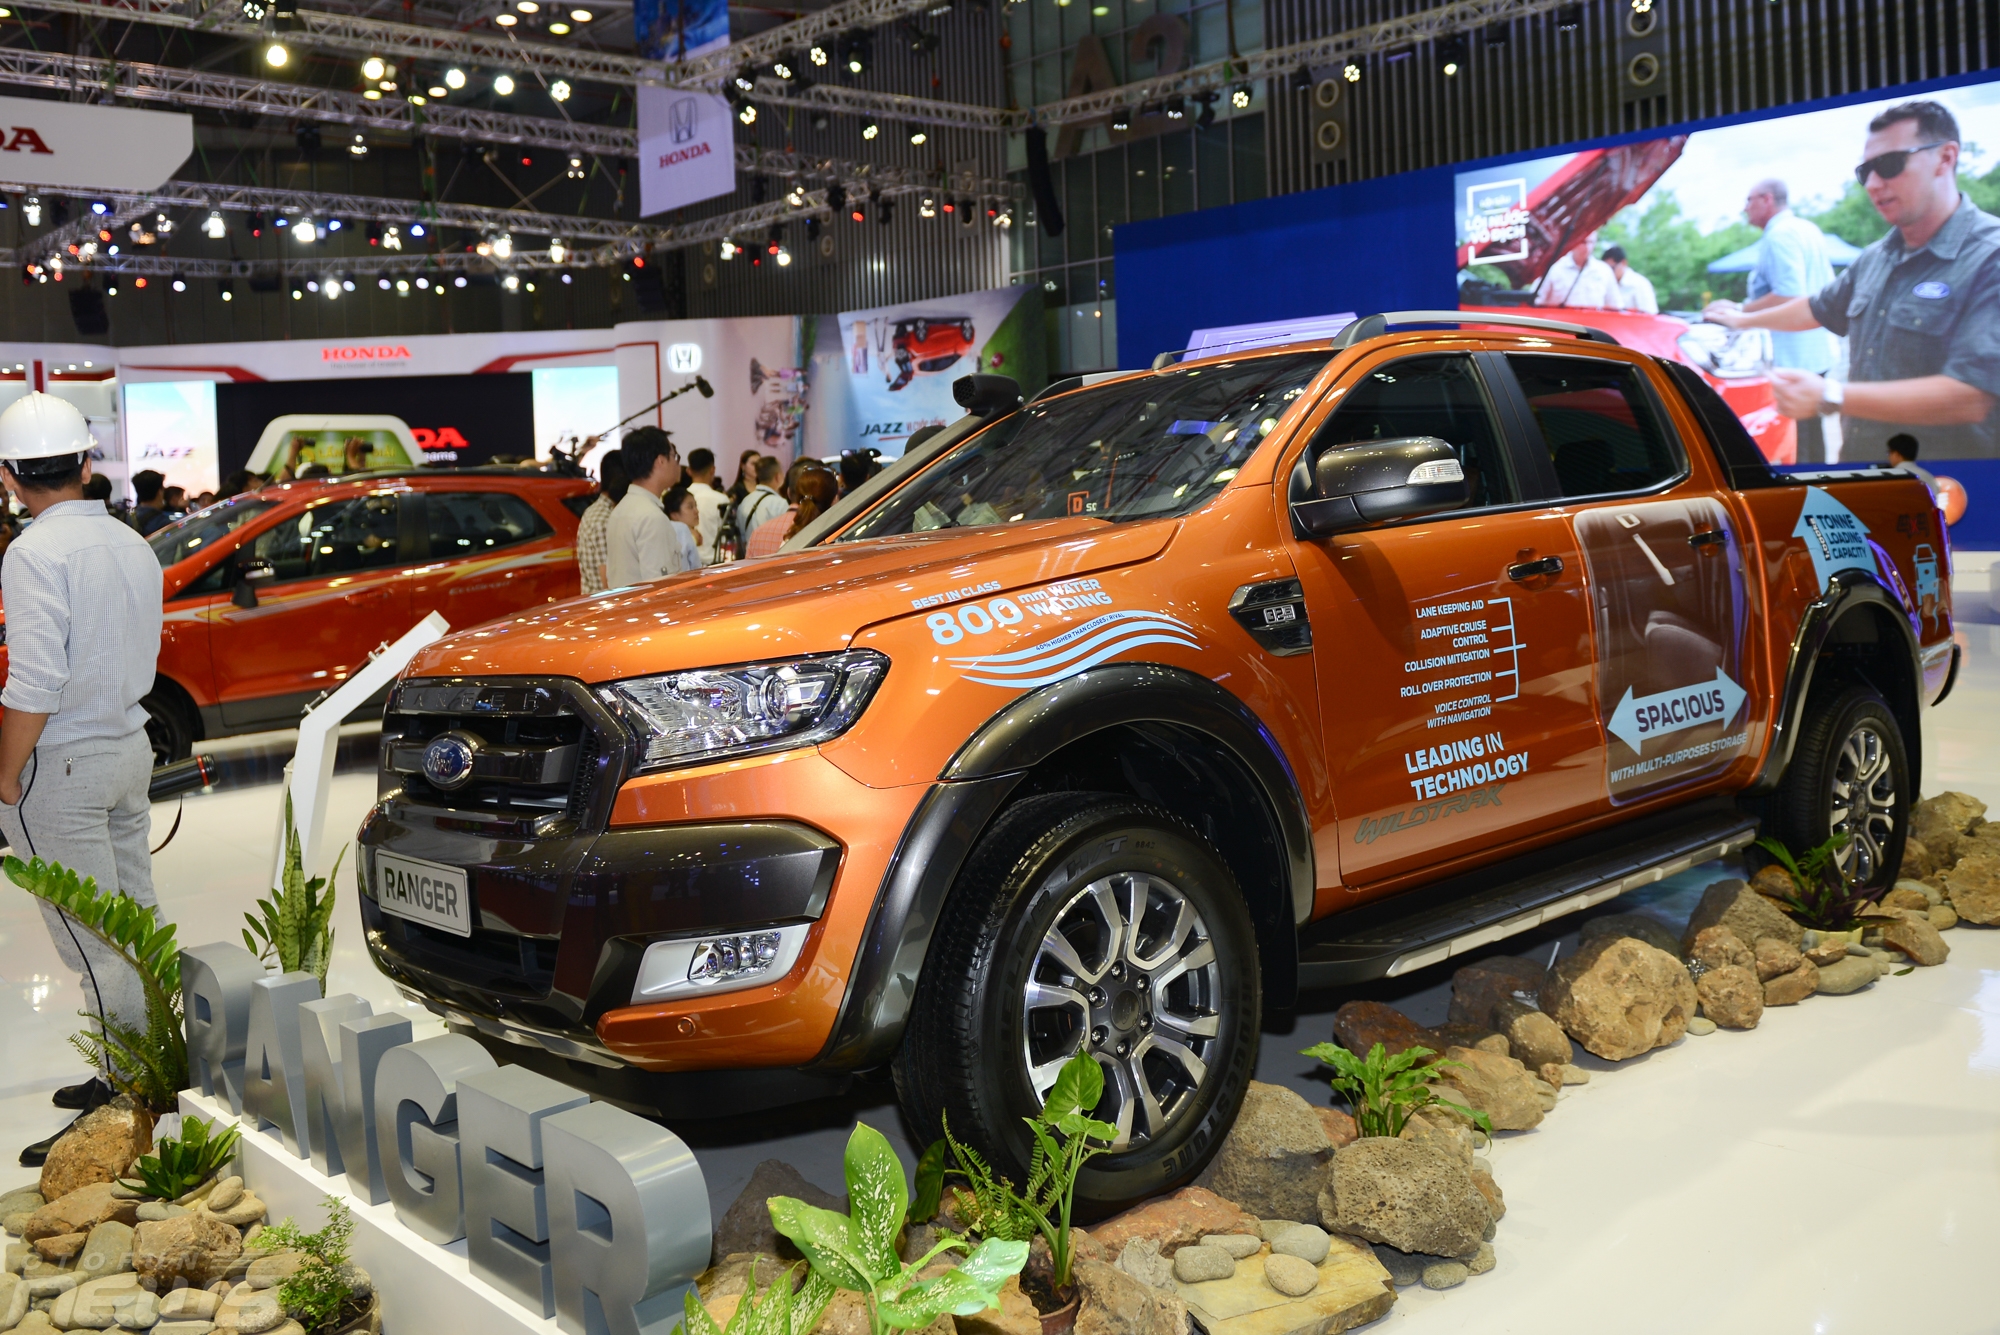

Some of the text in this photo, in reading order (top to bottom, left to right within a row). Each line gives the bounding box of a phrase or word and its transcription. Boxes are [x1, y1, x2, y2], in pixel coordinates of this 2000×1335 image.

[659, 142, 711, 169] HONDA
[321, 346, 411, 361] HONDA
[859, 422, 903, 436] JAZZ
[1816, 514, 1855, 530] TONNE
[1826, 532, 1862, 545] LOADING
[1833, 547, 1867, 560] CAPACITY
[911, 580, 1001, 609] BEST IN CLASS
[1017, 578, 1102, 604] mm WATER
[1025, 591, 1113, 617] WADING
[926, 598, 1024, 646] 800
[1416, 600, 1485, 619] LANE KEEPING AID
[1051, 633, 1072, 646] HIGHER
[1072, 627, 1087, 637] THAN
[1421, 620, 1487, 640] ADAPTIVE CRUISE
[1453, 633, 1489, 648] CONTROL
[1405, 648, 1490, 673] COLLISION MITIGATION
[1400, 671, 1492, 698] ROLL OVER PROTECTION
[1435, 694, 1492, 714] VOICE CONTROL
[1635, 689, 1725, 733] SPACIOUS
[1427, 706, 1491, 729] WITH NAVIGATION
[1404, 731, 1504, 774] LEADING IN
[1610, 732, 1748, 783] WITH MULTI-PURPOSES STORAGE
[1410, 752, 1529, 801] TECHNOLOGY
[1354, 783, 1507, 845] WILDTRAK
[384, 867, 459, 918] RANGER
[178, 941, 712, 1335] RANGER
